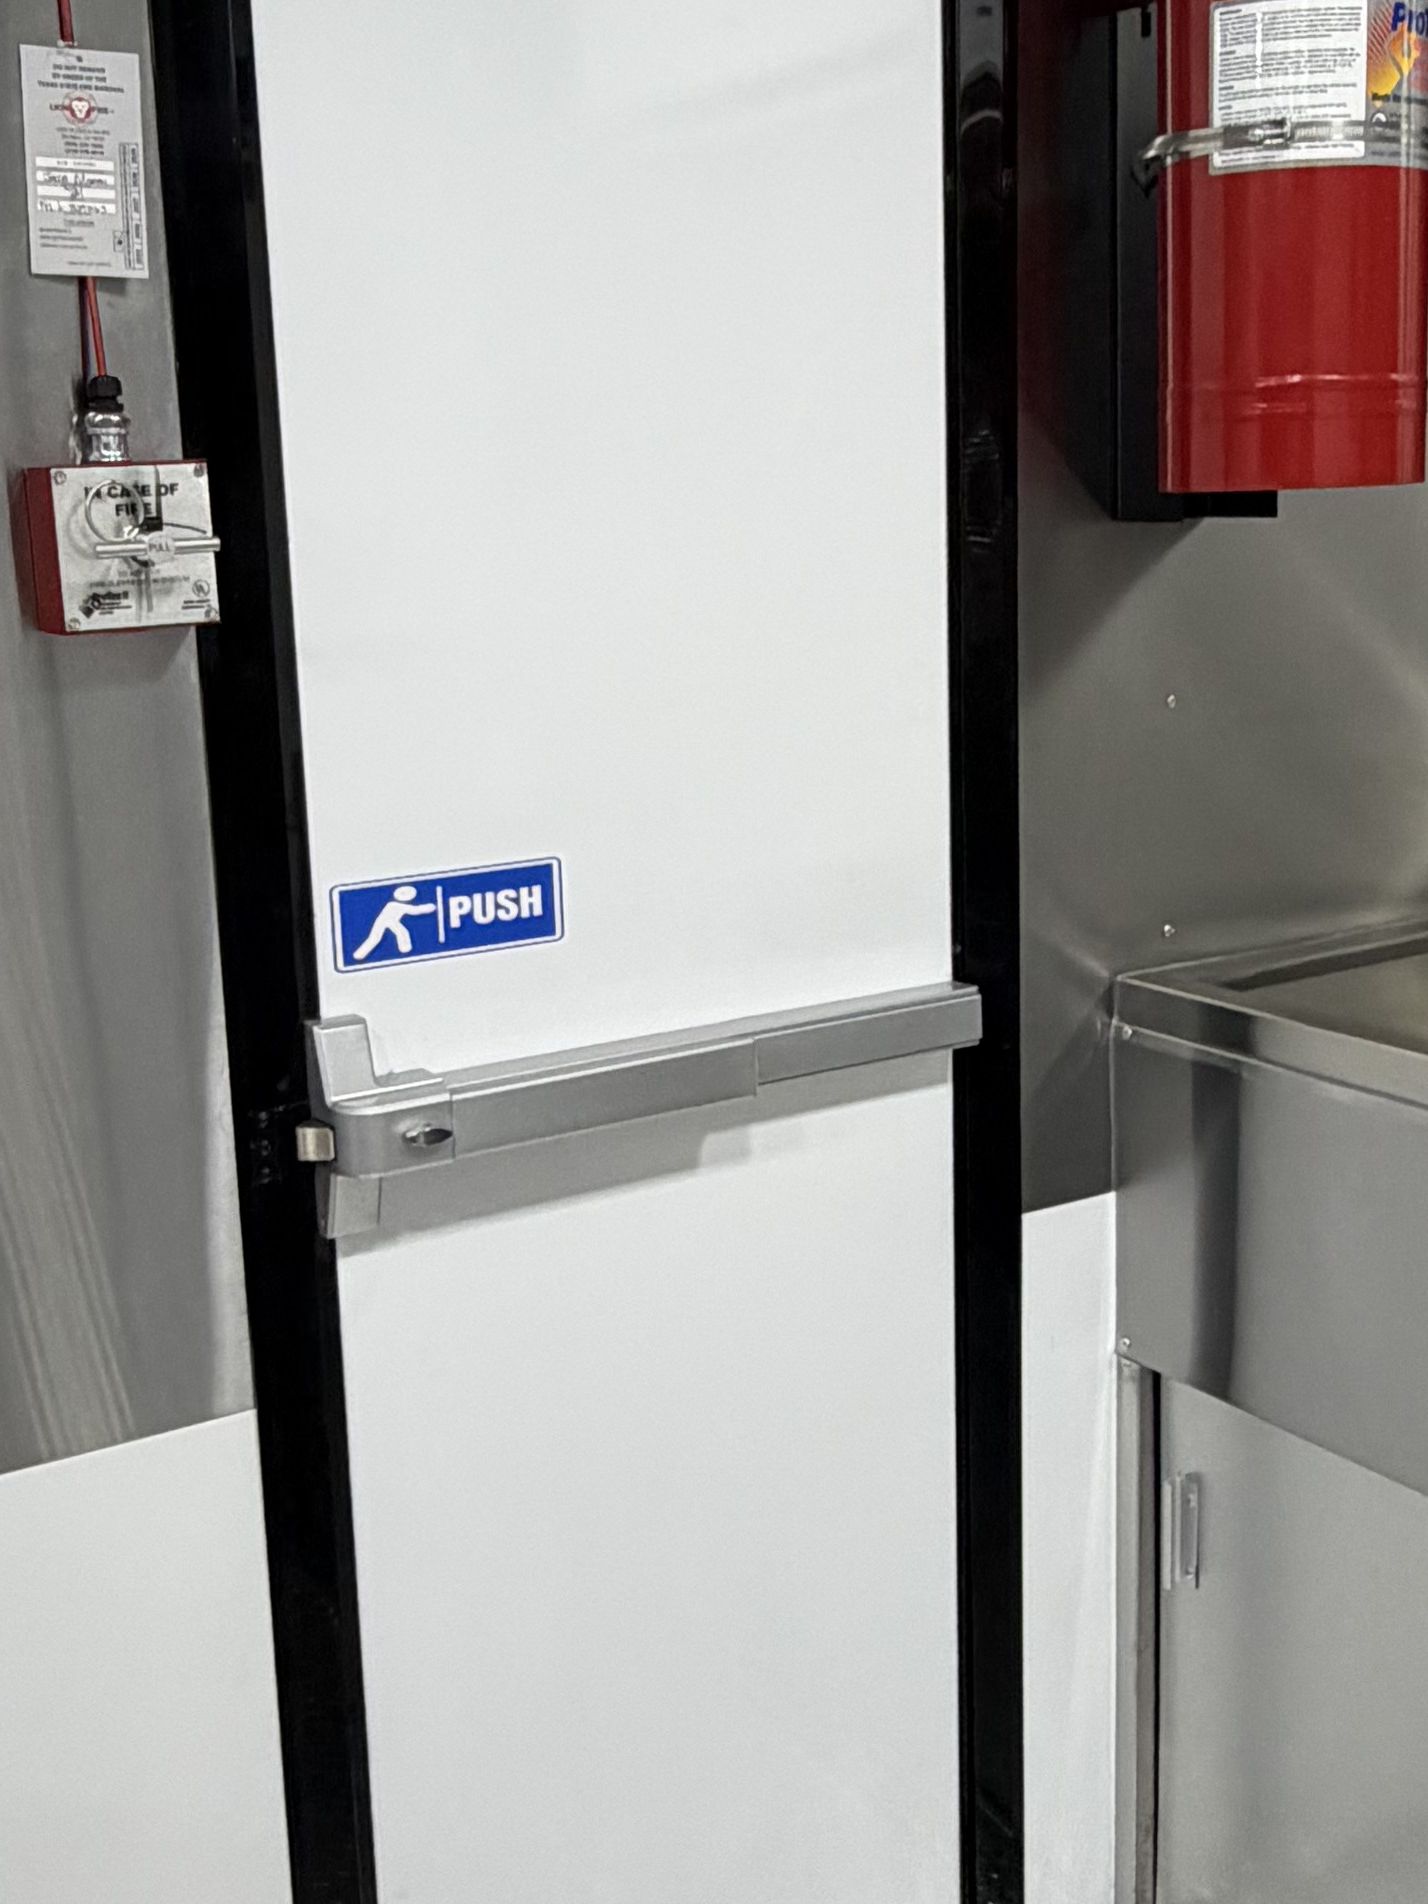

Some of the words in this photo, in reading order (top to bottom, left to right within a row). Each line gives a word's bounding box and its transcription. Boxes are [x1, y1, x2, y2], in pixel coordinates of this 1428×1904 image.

[159, 482, 179, 497] OF
[115, 500, 154, 517] FIRE
[448, 883, 544, 930] PUSH
